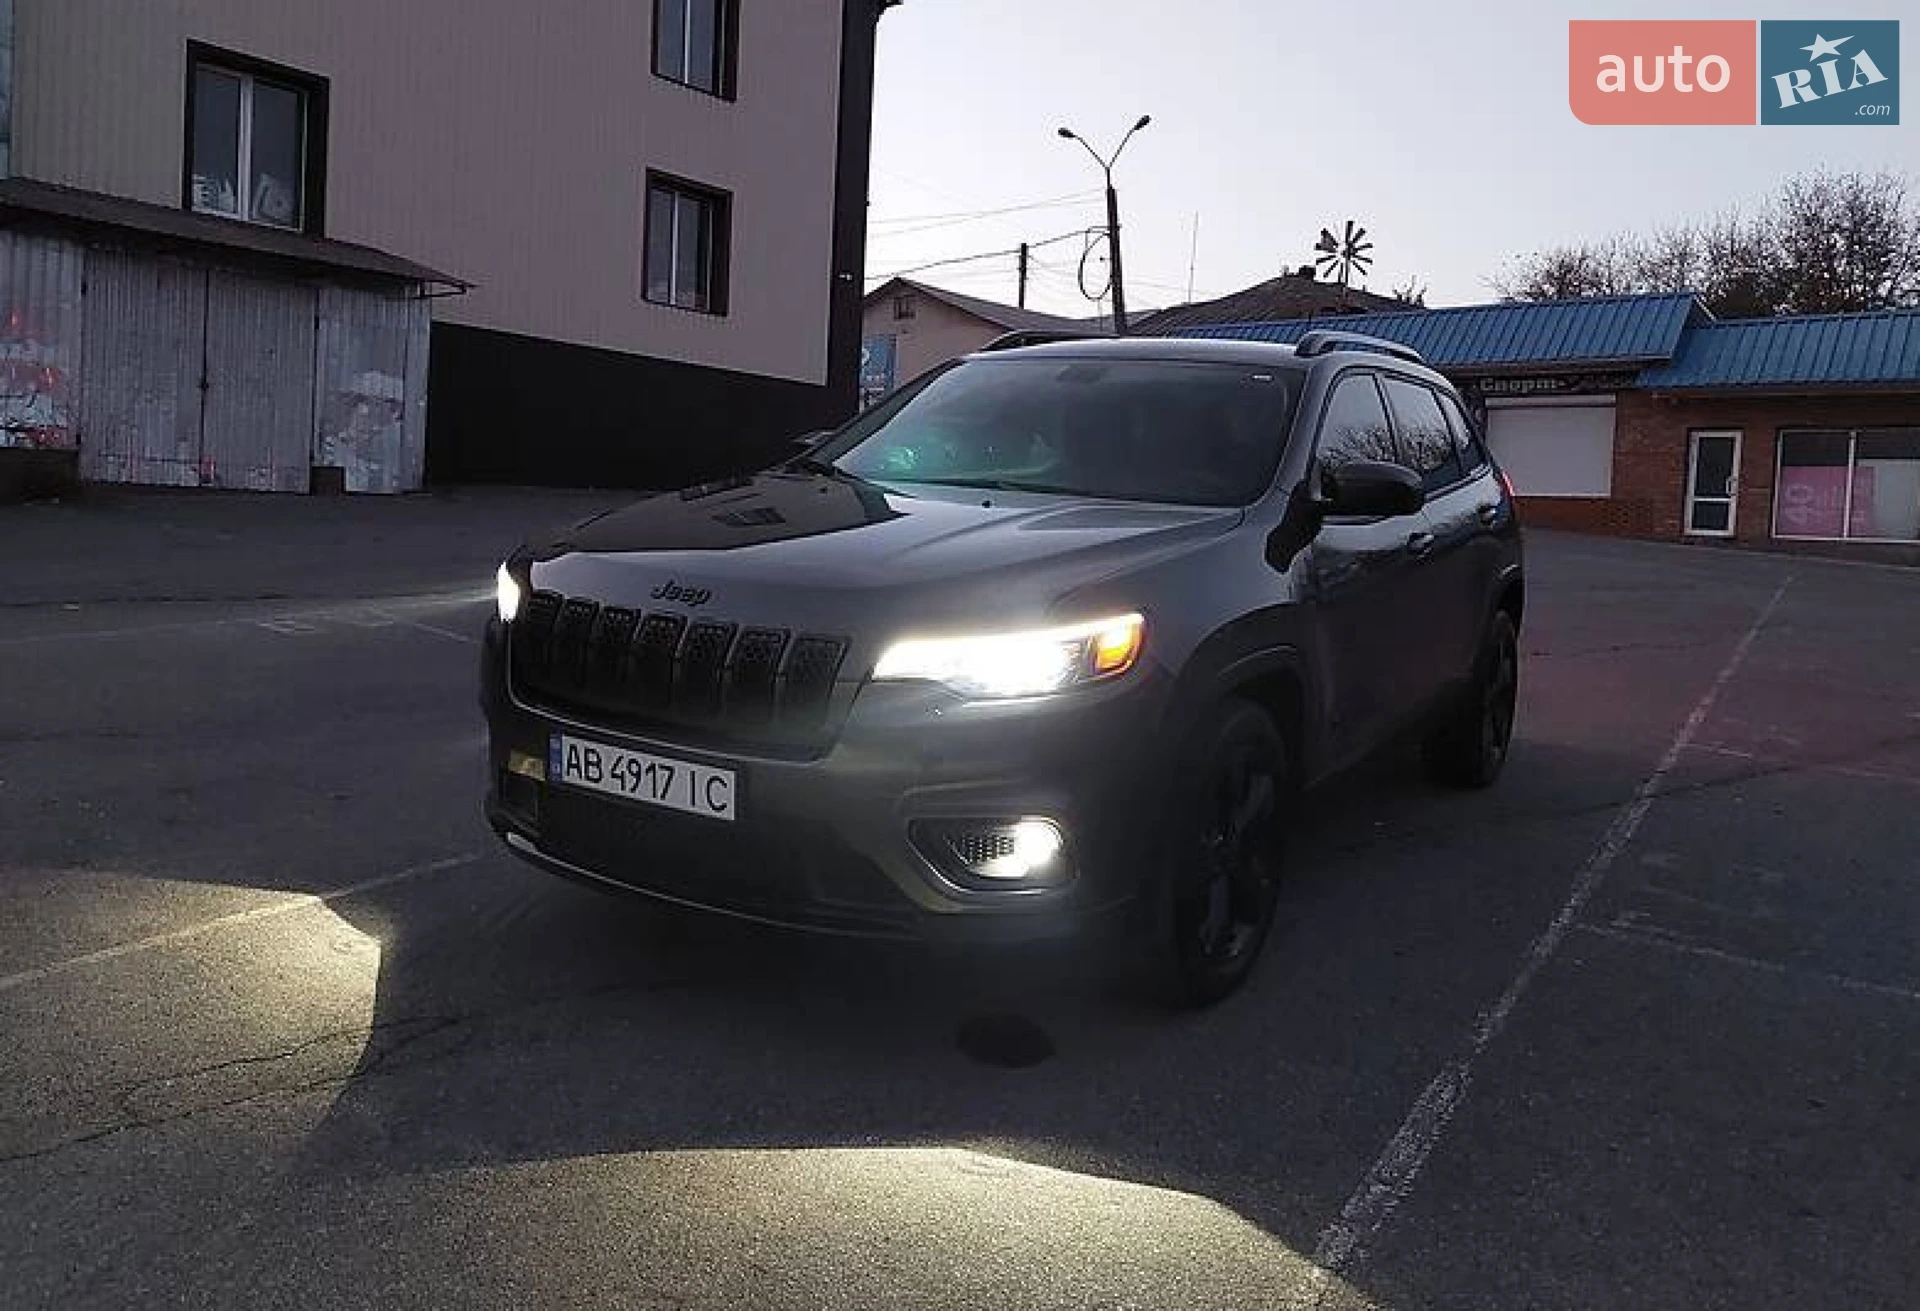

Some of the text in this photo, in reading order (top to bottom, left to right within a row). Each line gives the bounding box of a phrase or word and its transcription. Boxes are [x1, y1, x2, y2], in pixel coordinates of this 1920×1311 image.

[650, 579, 711, 607] Jeep
[566, 743, 602, 784] AB
[610, 755, 675, 801] 4917
[688, 770, 728, 812] IC
